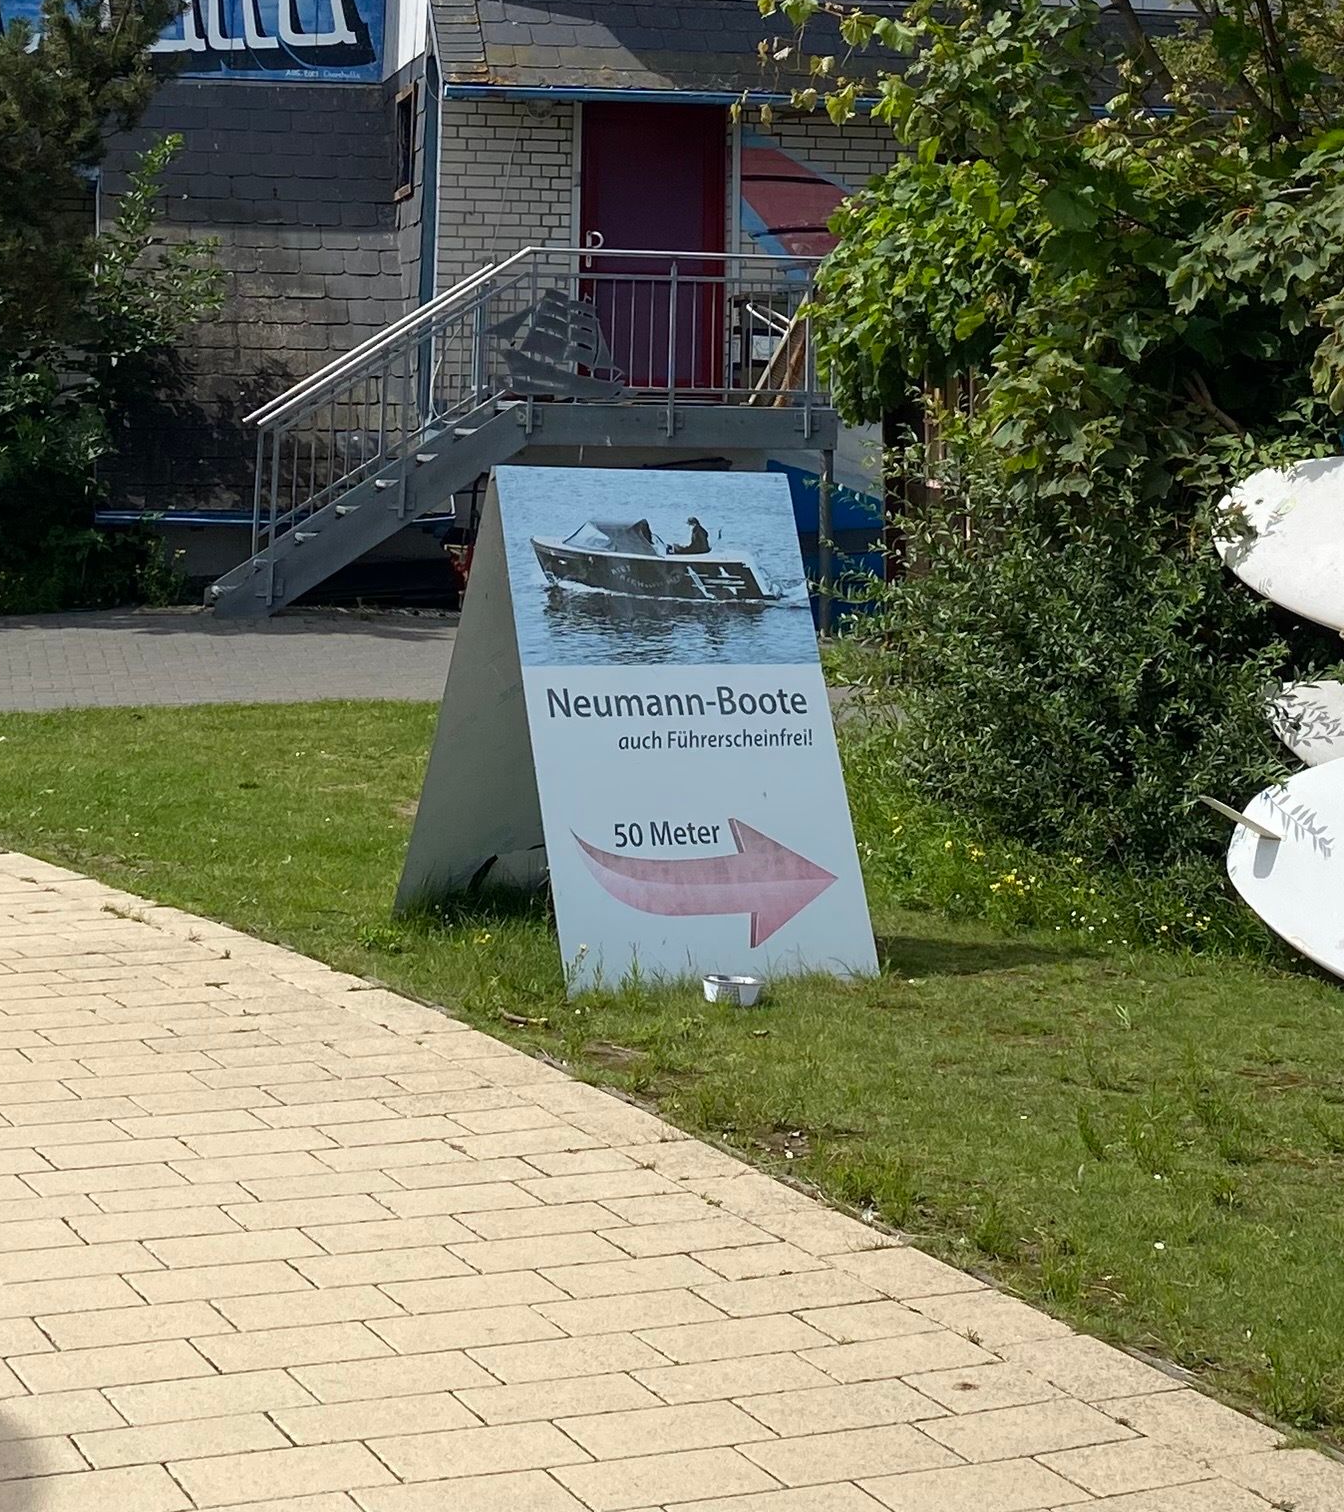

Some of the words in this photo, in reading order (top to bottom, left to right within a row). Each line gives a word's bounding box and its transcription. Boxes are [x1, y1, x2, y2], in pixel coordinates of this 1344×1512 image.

[546, 686, 808, 718] Neumann-Boote
[618, 730, 662, 750] auch
[667, 728, 814, 750] Führerscheinfrei!
[613, 823, 643, 848] 50
[649, 820, 721, 847] Meter
